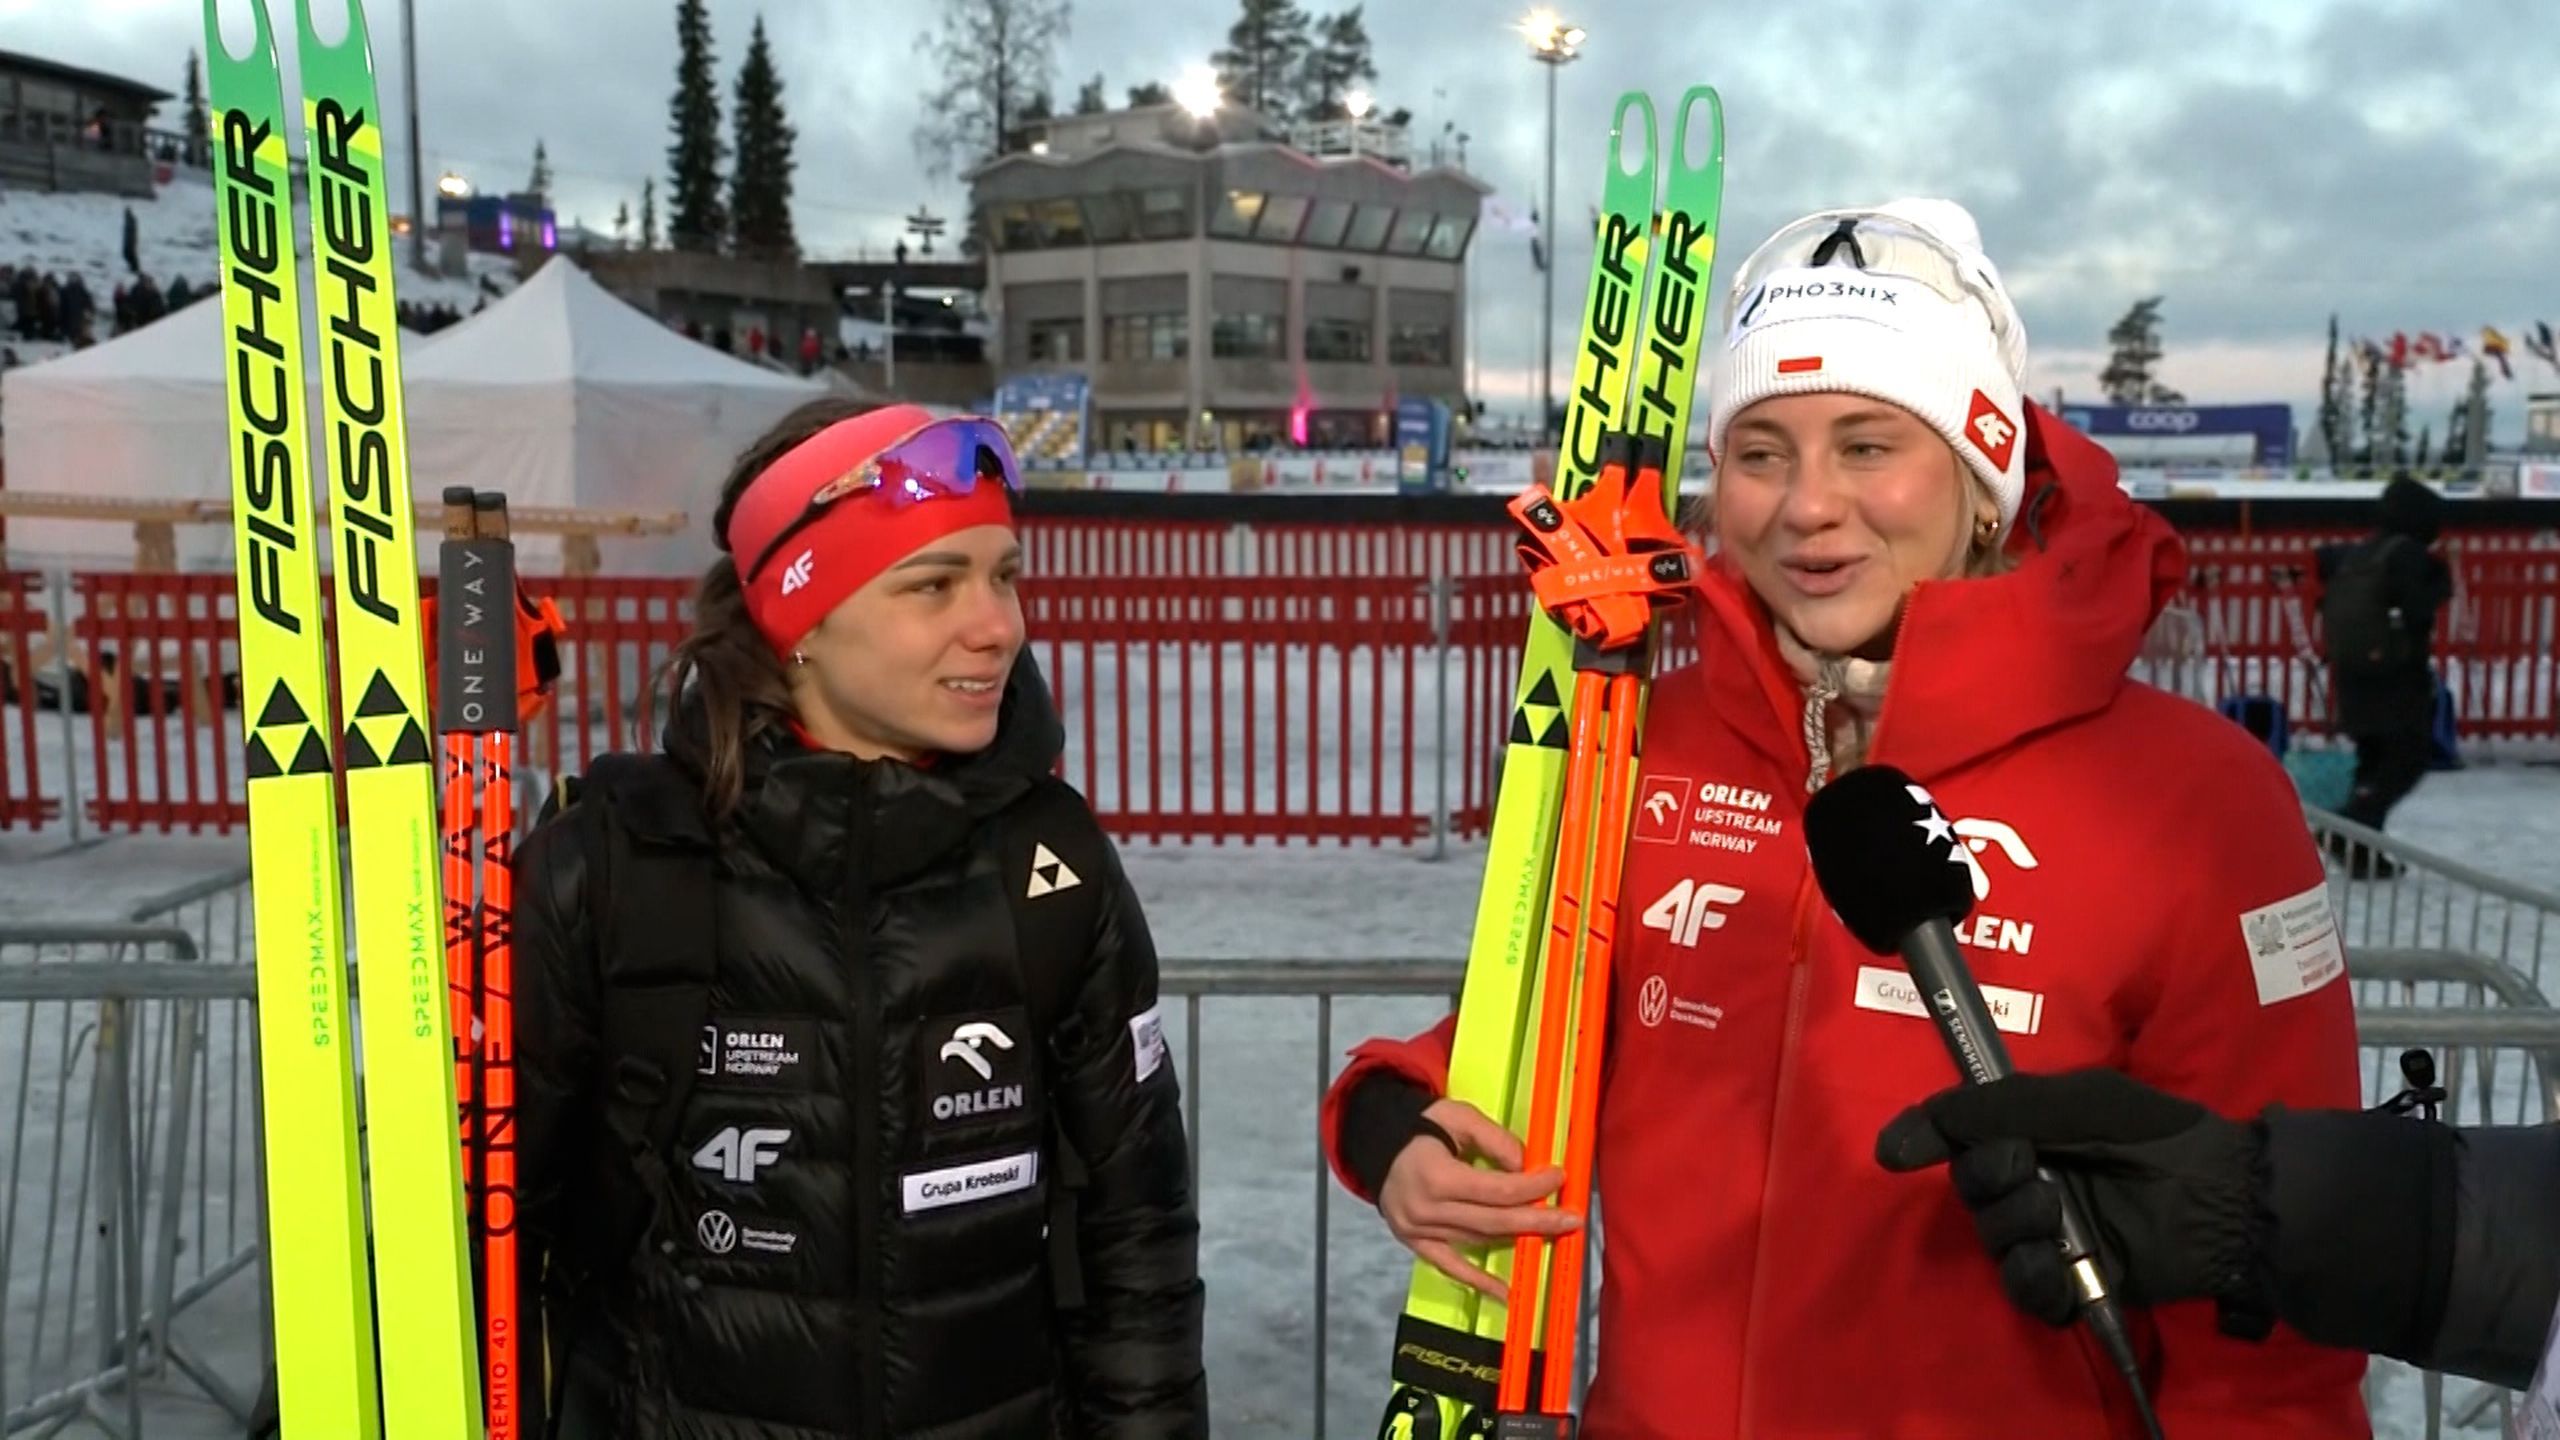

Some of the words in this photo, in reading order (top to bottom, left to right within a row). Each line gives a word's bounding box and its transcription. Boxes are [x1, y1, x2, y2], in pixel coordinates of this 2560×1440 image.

[1769, 281, 1899, 306] PHO3NIX
[223, 107, 300, 635] FISCHER
[315, 97, 400, 626] FISCHER
[1974, 411, 2013, 449] 4F
[2127, 411, 2198, 432] coop
[781, 549, 814, 597] 4F
[1699, 783, 1772, 812] ORLEN
[1694, 807, 1783, 836] UPSTREAM
[1689, 829, 1758, 853] NORWAY
[1642, 878, 1745, 949] 4F
[1953, 915, 2034, 955] LEN
[307, 910, 331, 1048] SPEEDMAX
[407, 901, 433, 1039] SPEEDMAX
[1877, 983, 1920, 1005] Grup
[725, 1031, 784, 1048] ORLEN
[932, 1084, 1023, 1120] ORLEN
[692, 1126, 792, 1182] 4F
[492, 1318, 508, 1349] 40
[492, 1362, 509, 1440] REMIO
